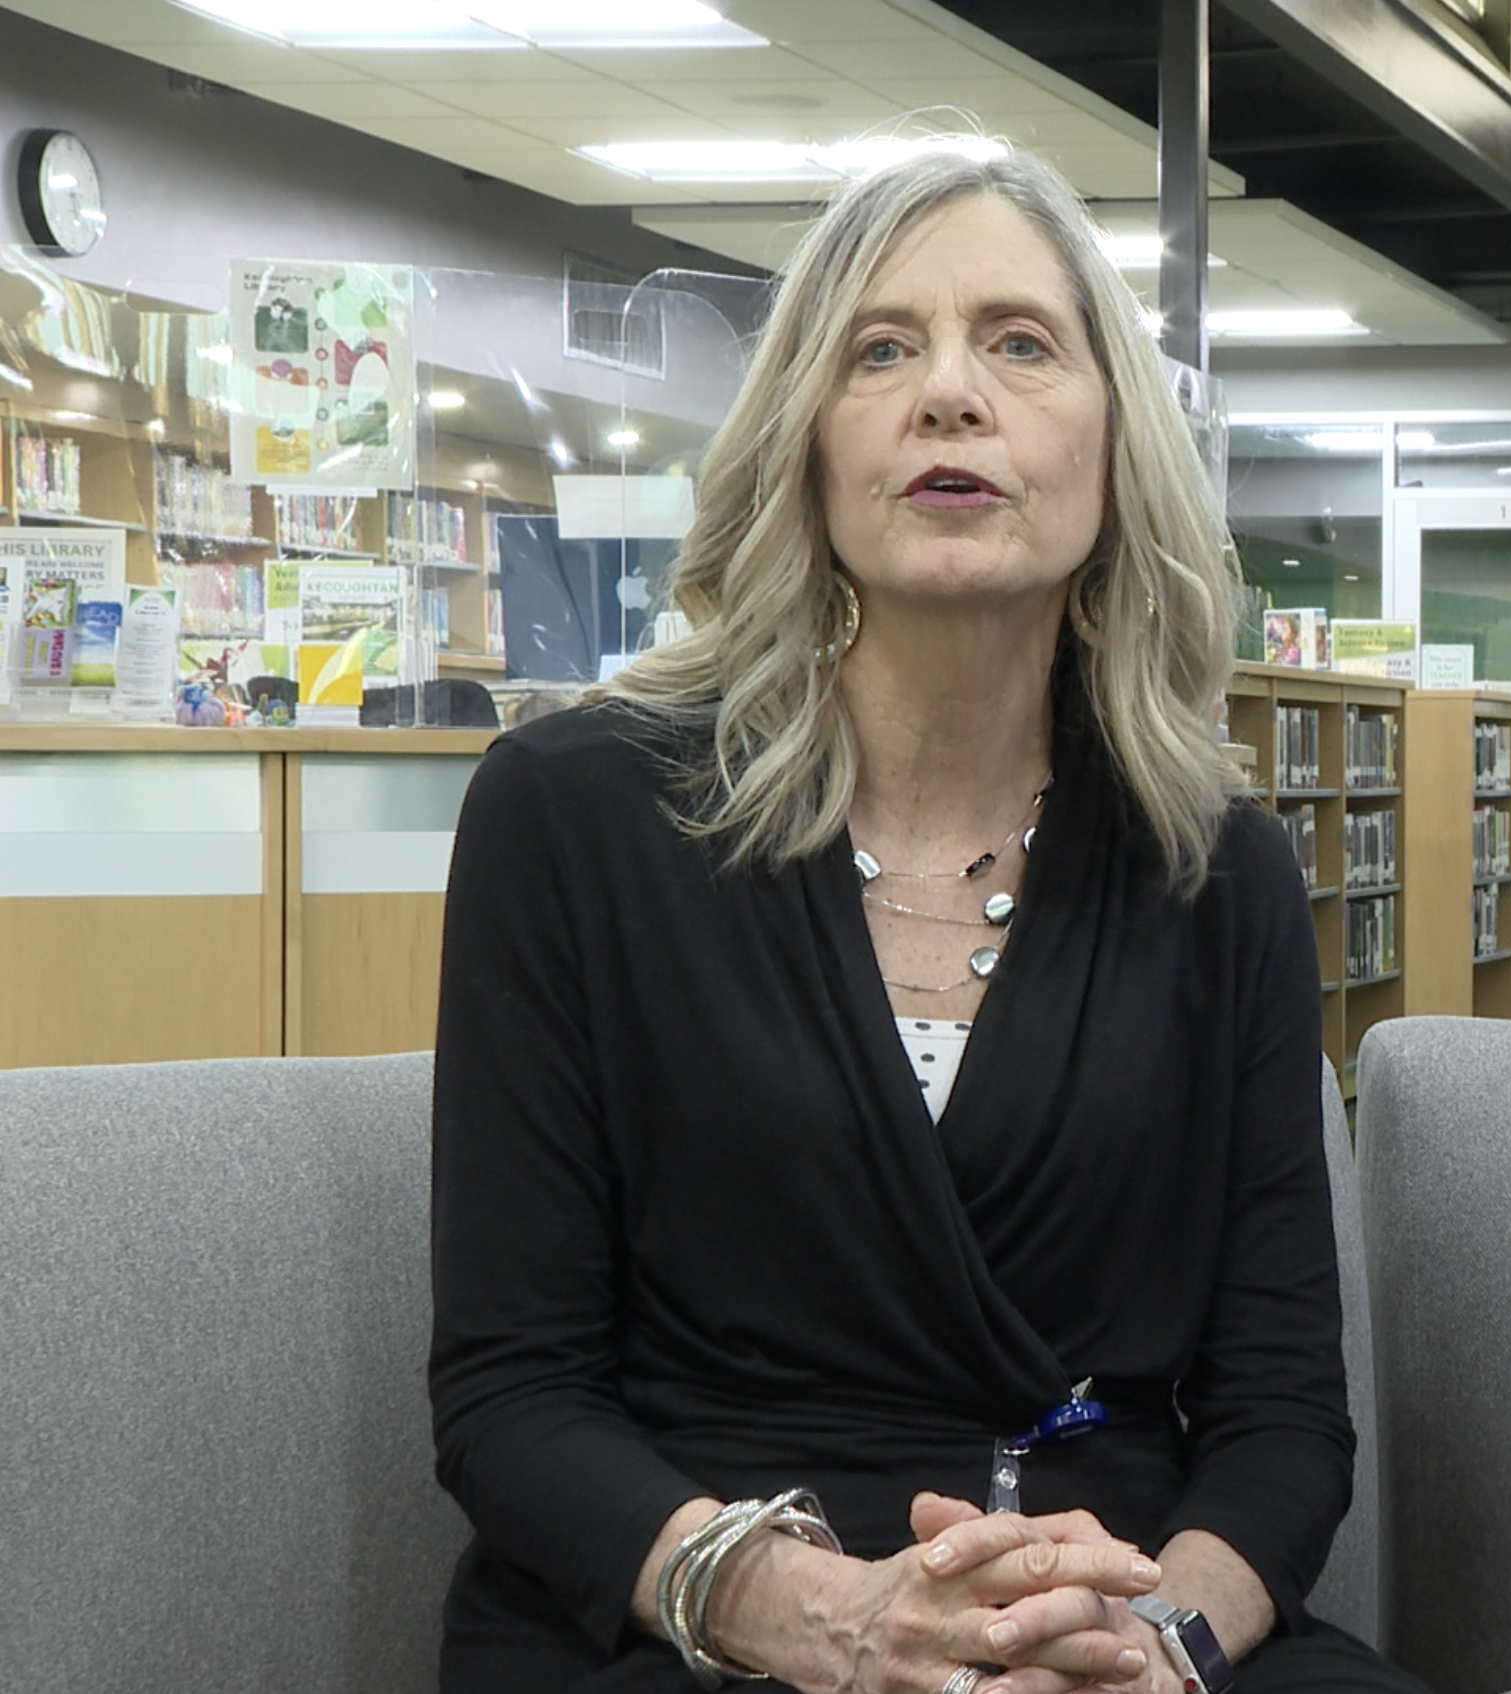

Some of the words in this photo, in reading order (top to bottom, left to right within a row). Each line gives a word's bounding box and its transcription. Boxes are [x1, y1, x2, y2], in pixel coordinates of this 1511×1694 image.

[1500, 505, 1506, 519] 1
[31, 544, 105, 557] LIBRARY
[46, 571, 105, 580] MATTERS
[307, 582, 399, 593] KECOUGHTAN
[1339, 629, 1374, 638] Fantasy
